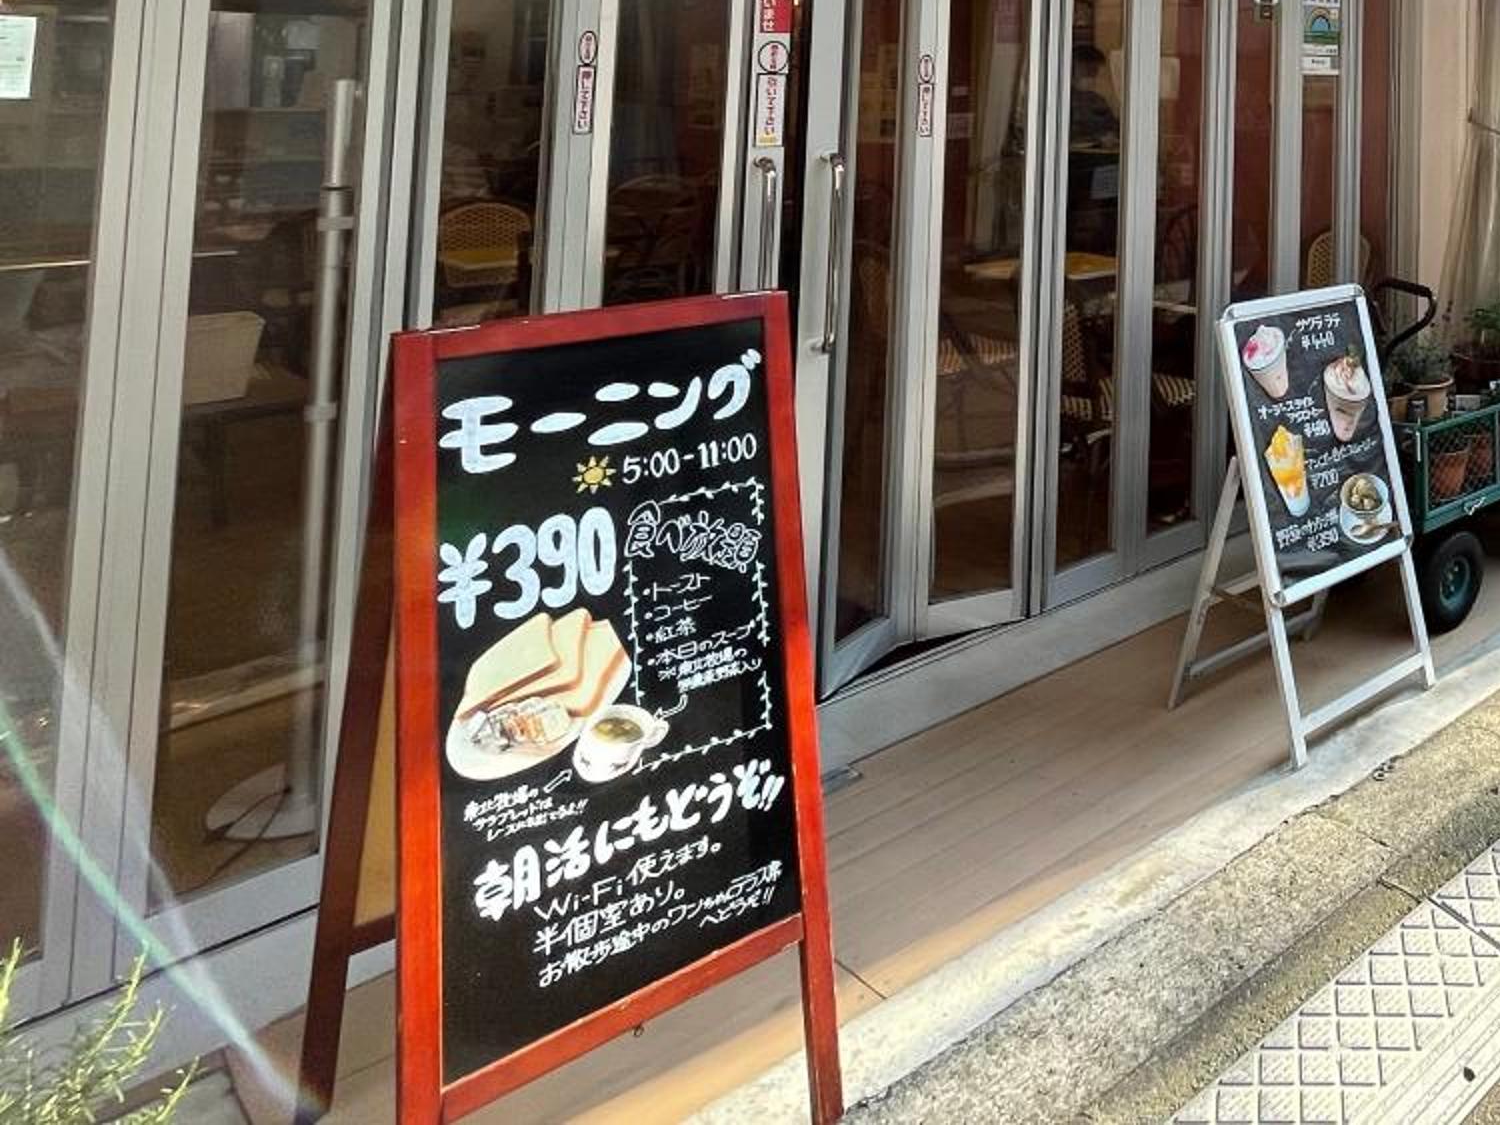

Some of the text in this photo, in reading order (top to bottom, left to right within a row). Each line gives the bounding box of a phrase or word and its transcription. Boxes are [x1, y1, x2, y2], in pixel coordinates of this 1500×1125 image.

[438, 348, 762, 474] モーニング
[437, 506, 617, 629] ¥390
